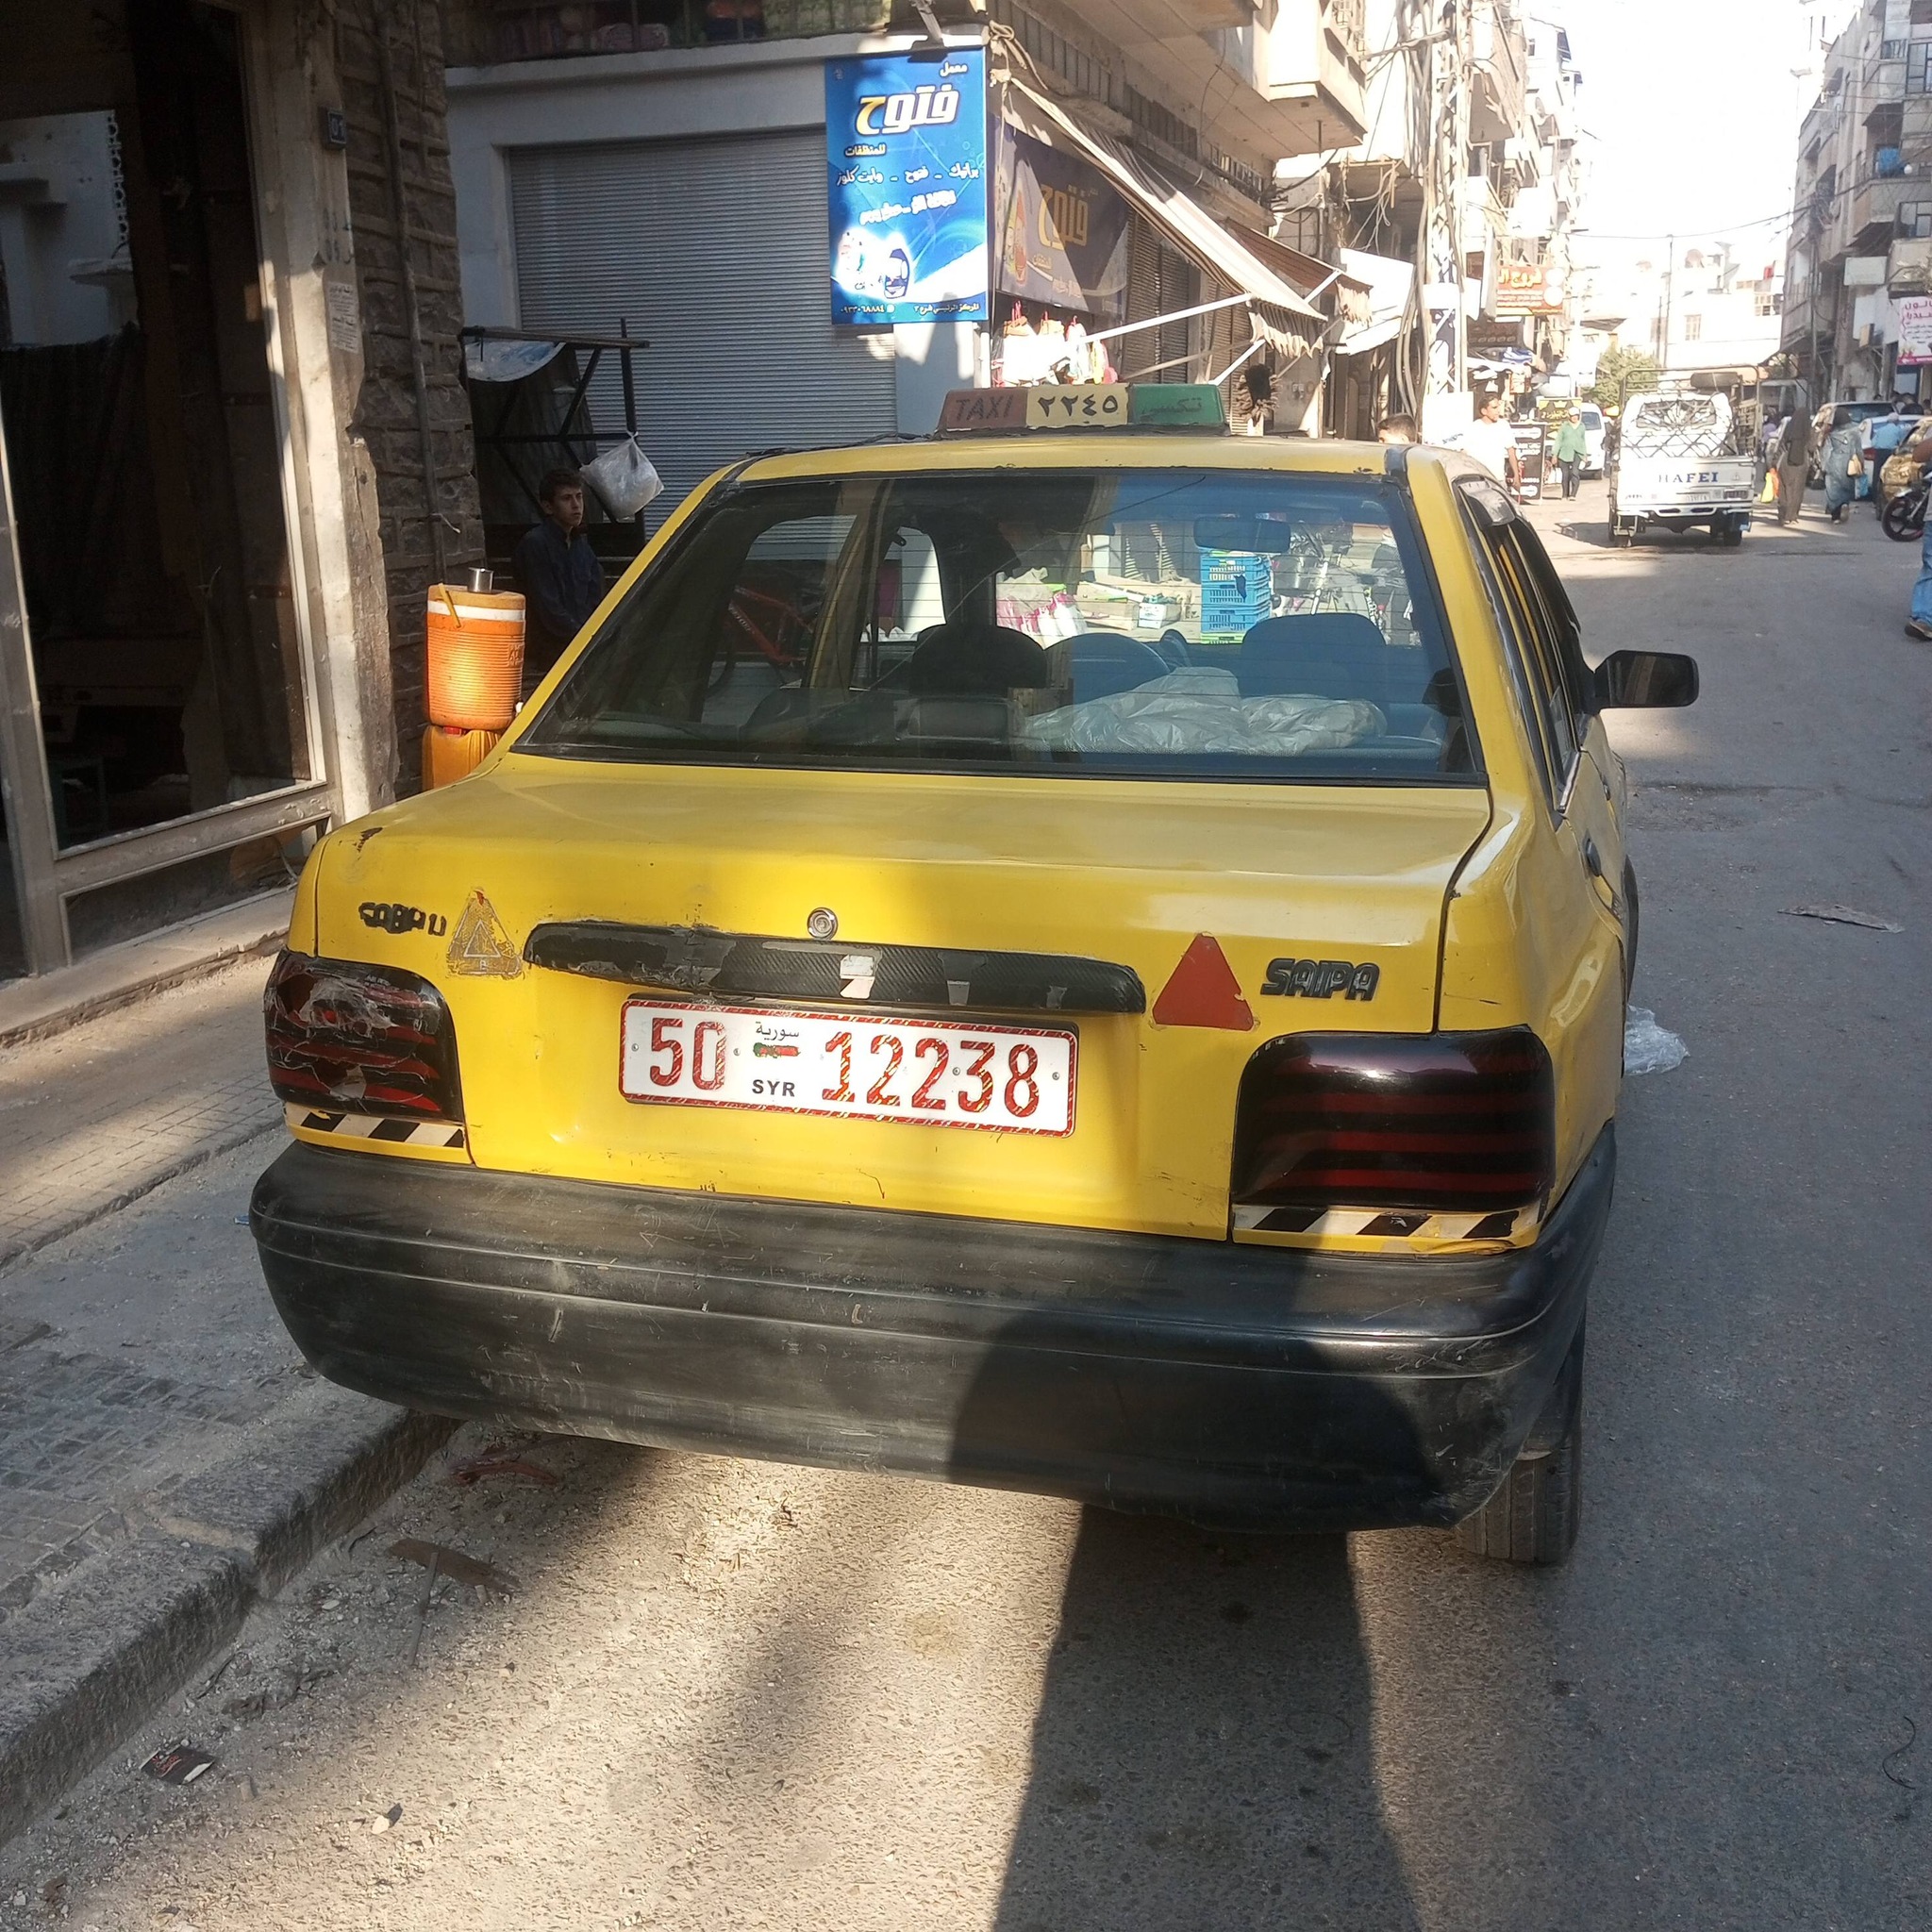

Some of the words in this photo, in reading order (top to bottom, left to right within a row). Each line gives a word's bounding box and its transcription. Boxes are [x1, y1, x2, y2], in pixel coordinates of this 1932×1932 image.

[940, 61, 968, 77] معمل
[855, 84, 960, 136] فتوح
[844, 142, 886, 157] للمنظفات
[1038, 183, 1089, 251] فتوح
[955, 394, 1013, 422] TAXI
[1038, 393, 1119, 417] ٢٢٤٥
[1658, 472, 1719, 483] HAFEI
[1260, 958, 1380, 1001] SAIPA
[754, 1021, 800, 1041] سورية
[649, 1017, 725, 1091] 50
[822, 1031, 1040, 1118] 12238
[752, 1078, 795, 1097] SYR
